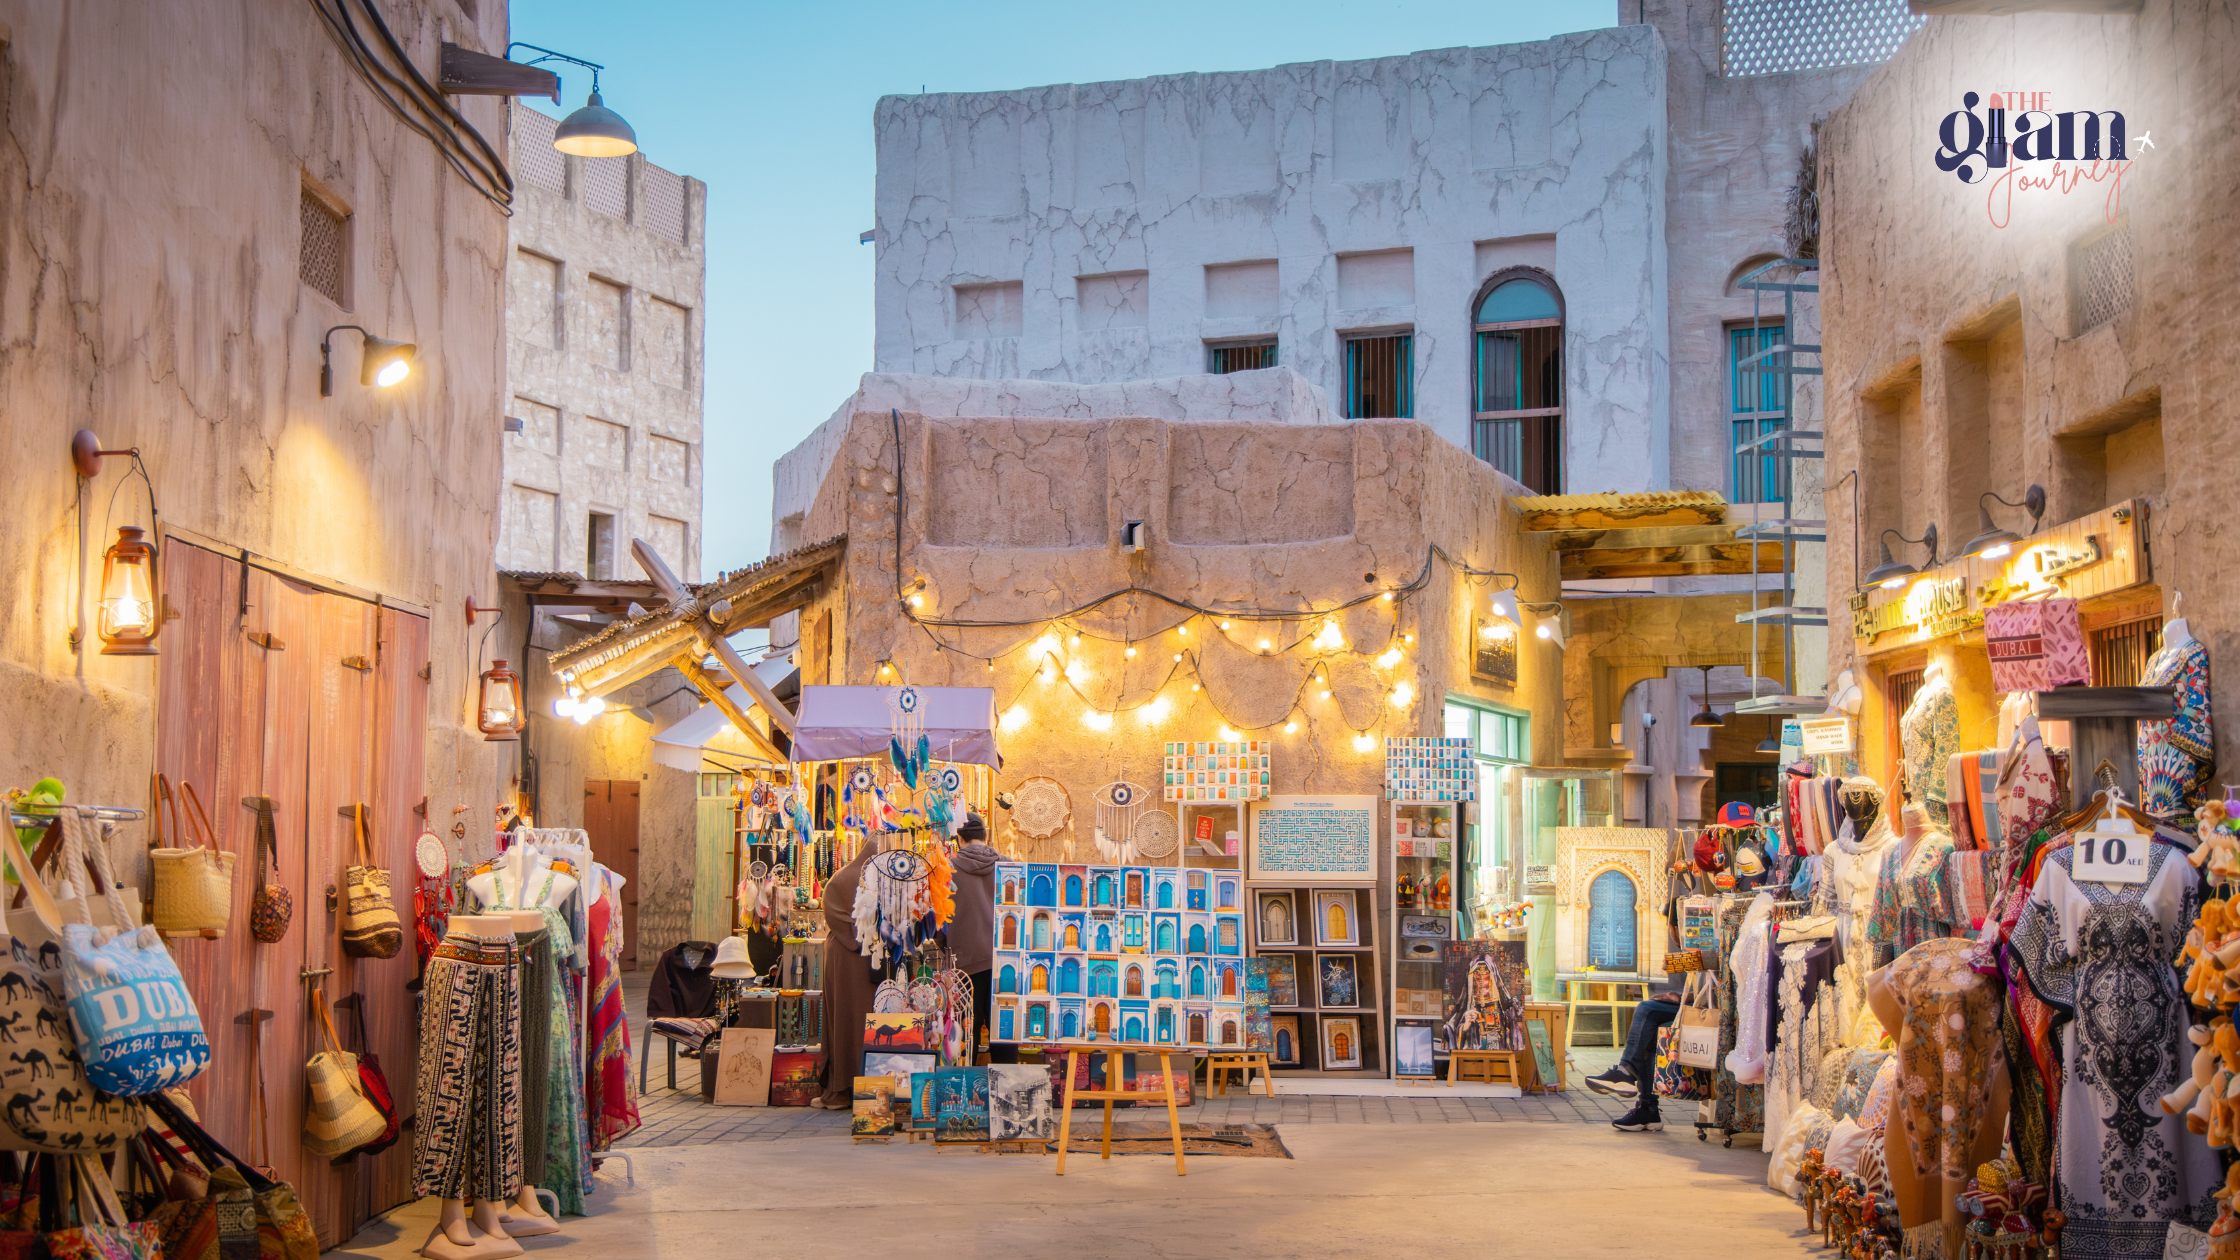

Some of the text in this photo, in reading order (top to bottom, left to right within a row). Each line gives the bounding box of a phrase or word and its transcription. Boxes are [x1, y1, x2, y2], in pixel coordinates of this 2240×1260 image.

[1848, 592, 1868, 611] THE
[1995, 640, 2032, 656] DUBAI
[2080, 838, 2144, 866] 10 AED
[97, 1030, 125, 1047] UBAI
[101, 1035, 157, 1063] DUBAI
[161, 1034, 184, 1050] Dubai
[1683, 1041, 1709, 1055] DUBAI
